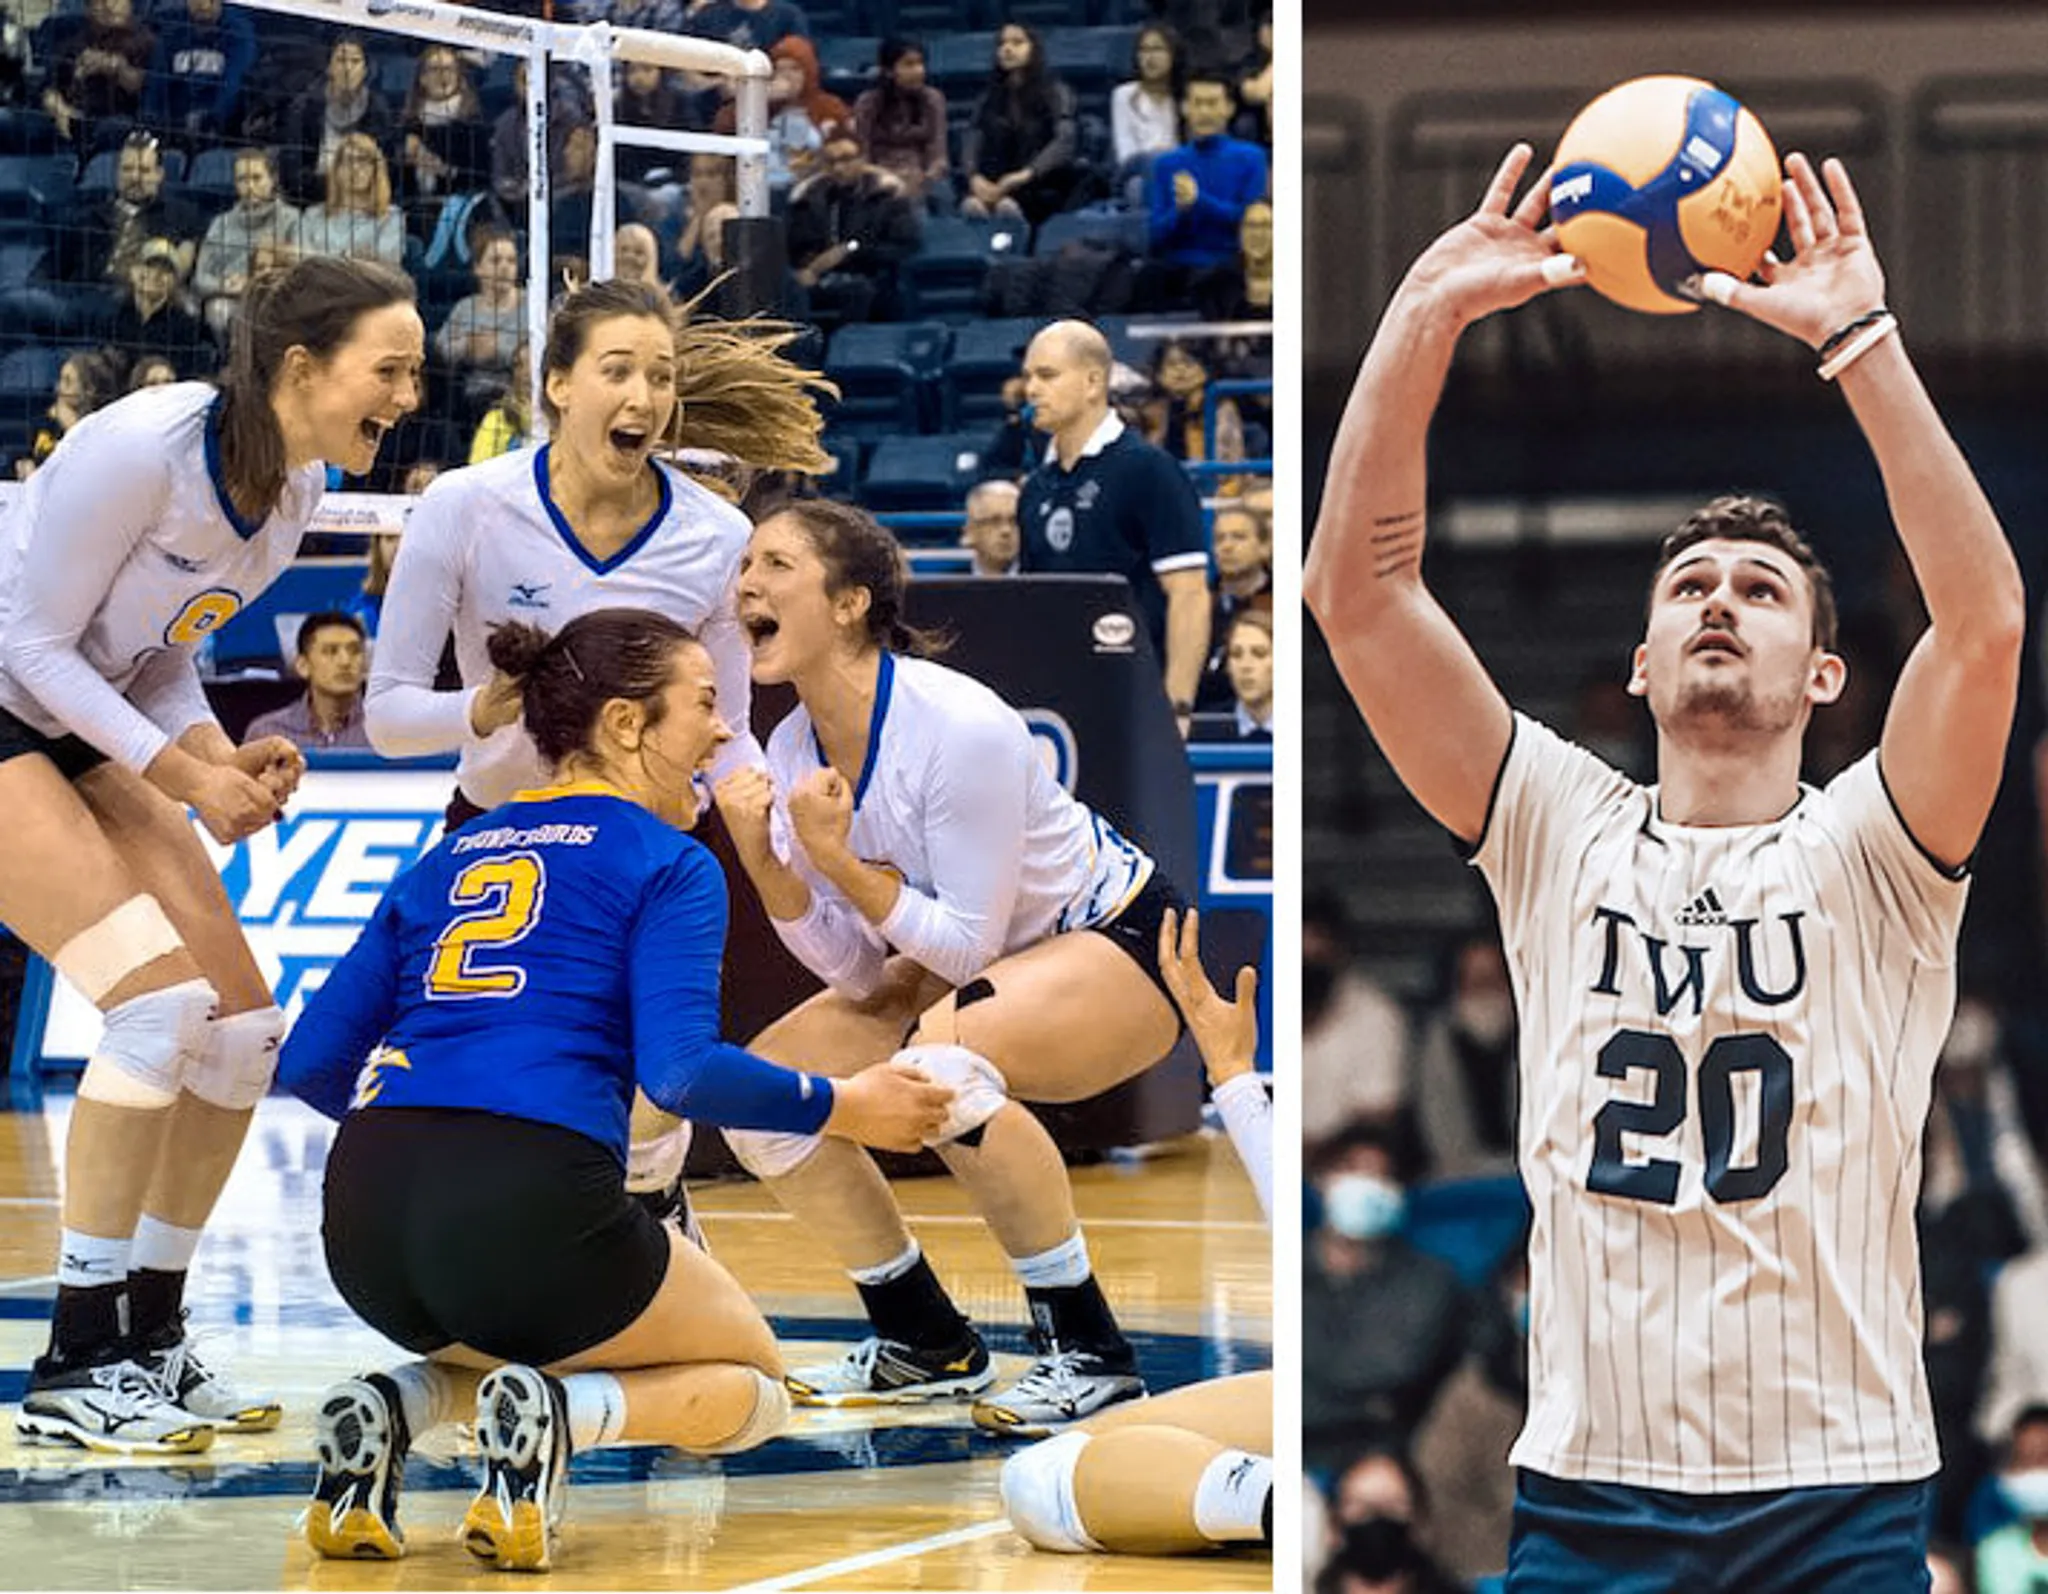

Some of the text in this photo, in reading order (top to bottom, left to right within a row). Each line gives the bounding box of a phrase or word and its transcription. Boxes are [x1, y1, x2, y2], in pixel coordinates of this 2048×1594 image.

[192, 818, 445, 918] YE
[425, 850, 546, 1001] 2
[1589, 906, 1806, 1016] TWU
[1586, 1028, 1794, 1204] 20
